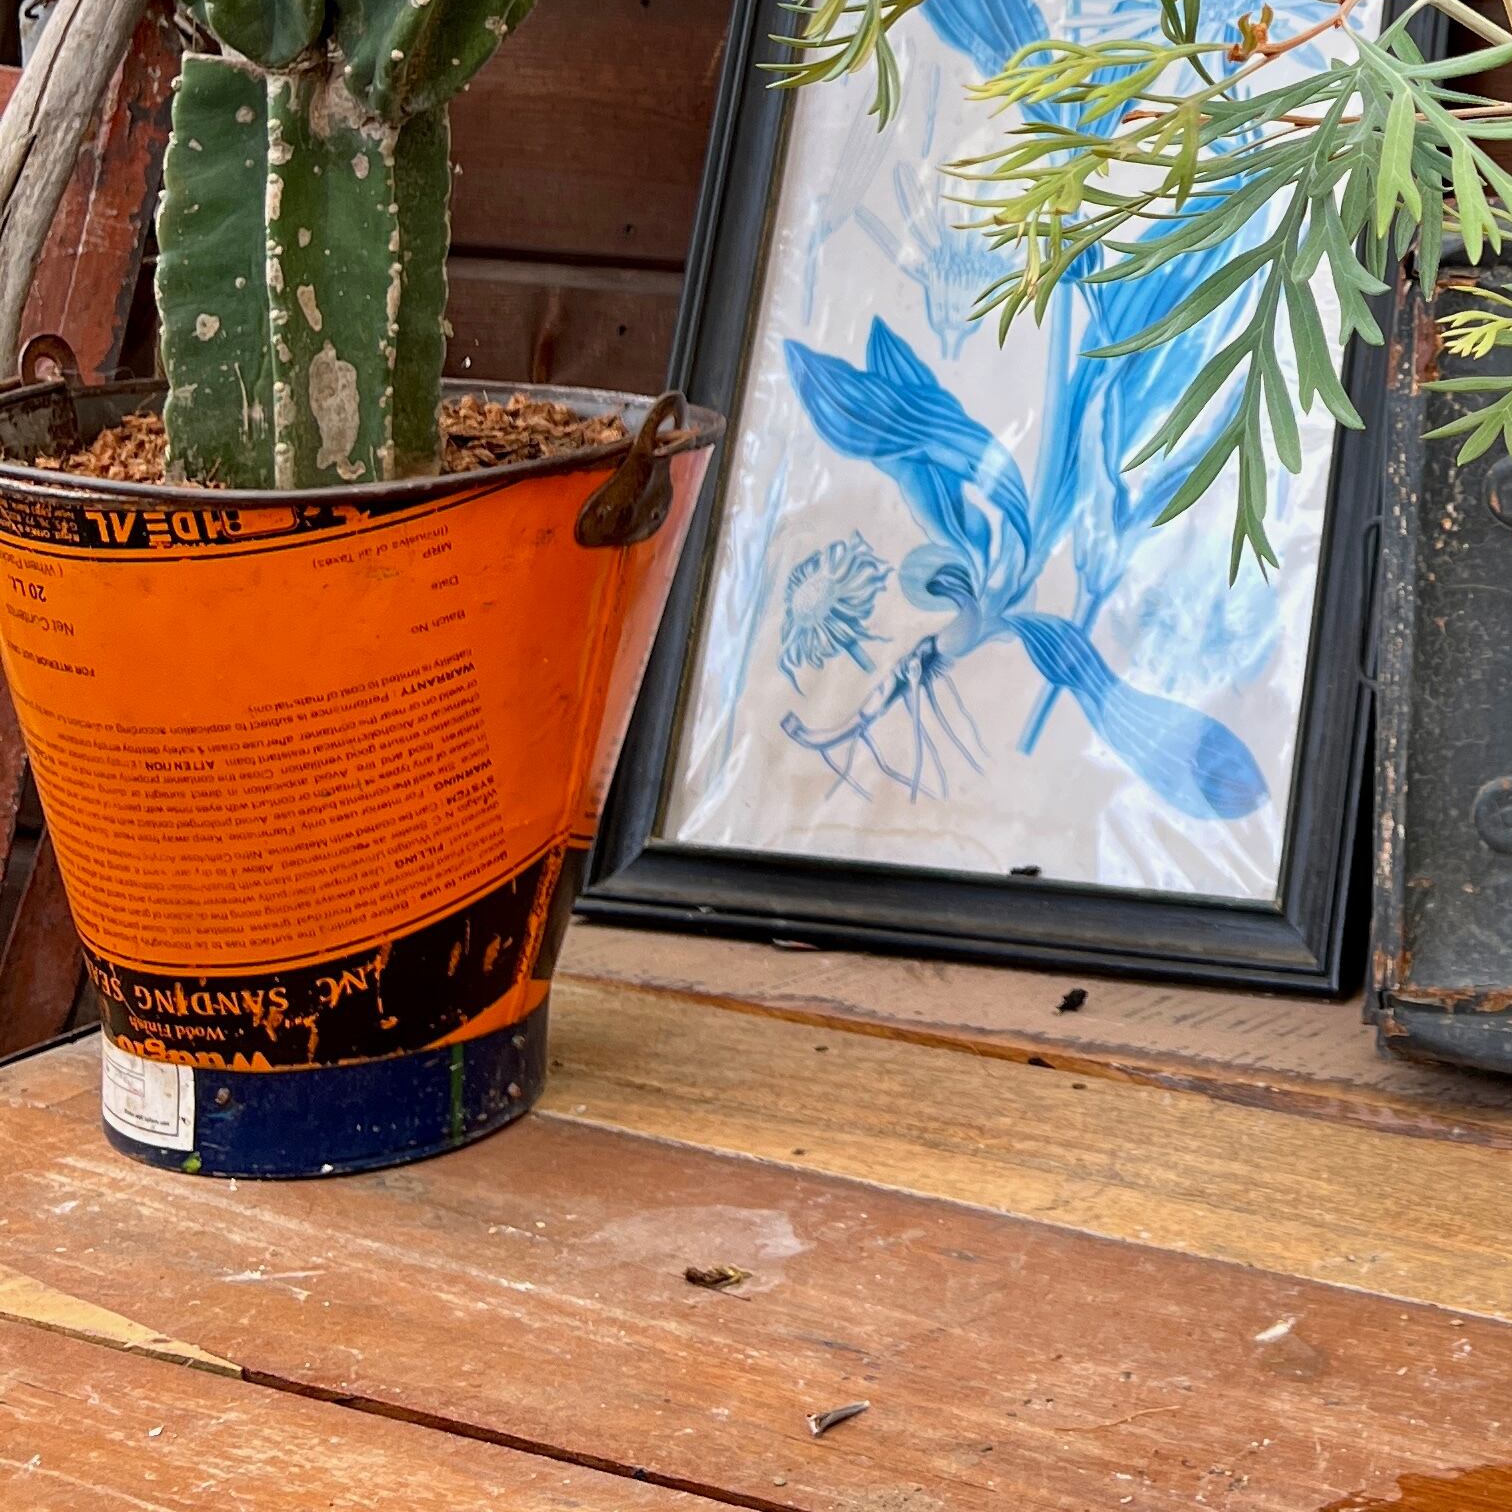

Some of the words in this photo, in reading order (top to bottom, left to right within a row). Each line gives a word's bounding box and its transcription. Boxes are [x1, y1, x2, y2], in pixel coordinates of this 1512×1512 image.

[419, 538, 452, 559] MRP
[428, 572, 459, 590] Date
[26, 581, 46, 603] 20
[50, 618, 74, 637] Net
[429, 607, 466, 628] Batch
[34, 653, 73, 673] INTERIOR
[73, 663, 95, 677] FOR
[131, 982, 288, 1017] SANDING
[126, 1013, 172, 1038] Finish
[173, 1023, 224, 1041] Wood
